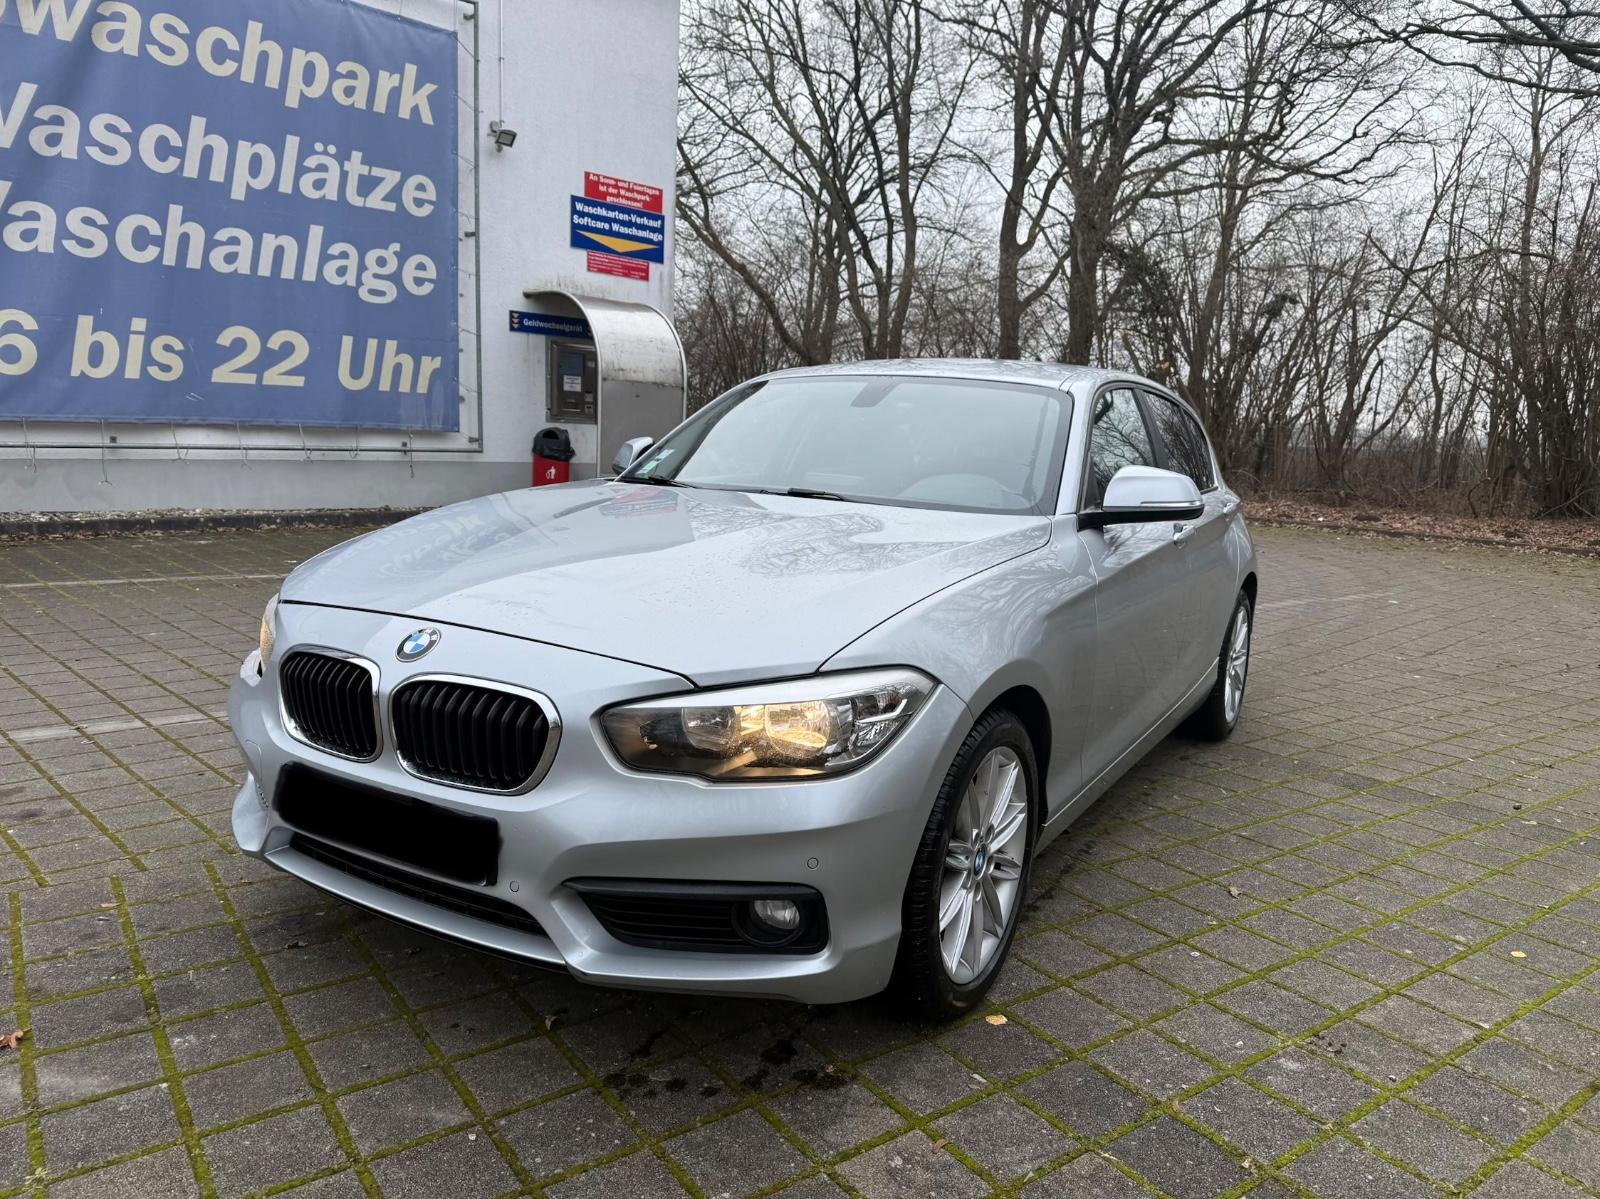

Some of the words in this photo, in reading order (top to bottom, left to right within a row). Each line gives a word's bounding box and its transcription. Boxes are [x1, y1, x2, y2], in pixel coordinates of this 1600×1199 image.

[0, 0, 438, 125] waschpark
[575, 202, 662, 228] Waschkarten-Verkauf
[608, 186, 618, 194] der
[620, 188, 650, 202] Waschpark
[0, 180, 437, 303] aschanlage
[573, 215, 610, 230] Softcare
[611, 222, 663, 241] Waschanlage
[0, 308, 39, 376] 6
[71, 314, 185, 382] bis
[211, 325, 310, 387] 22
[338, 335, 442, 394] Uhr
